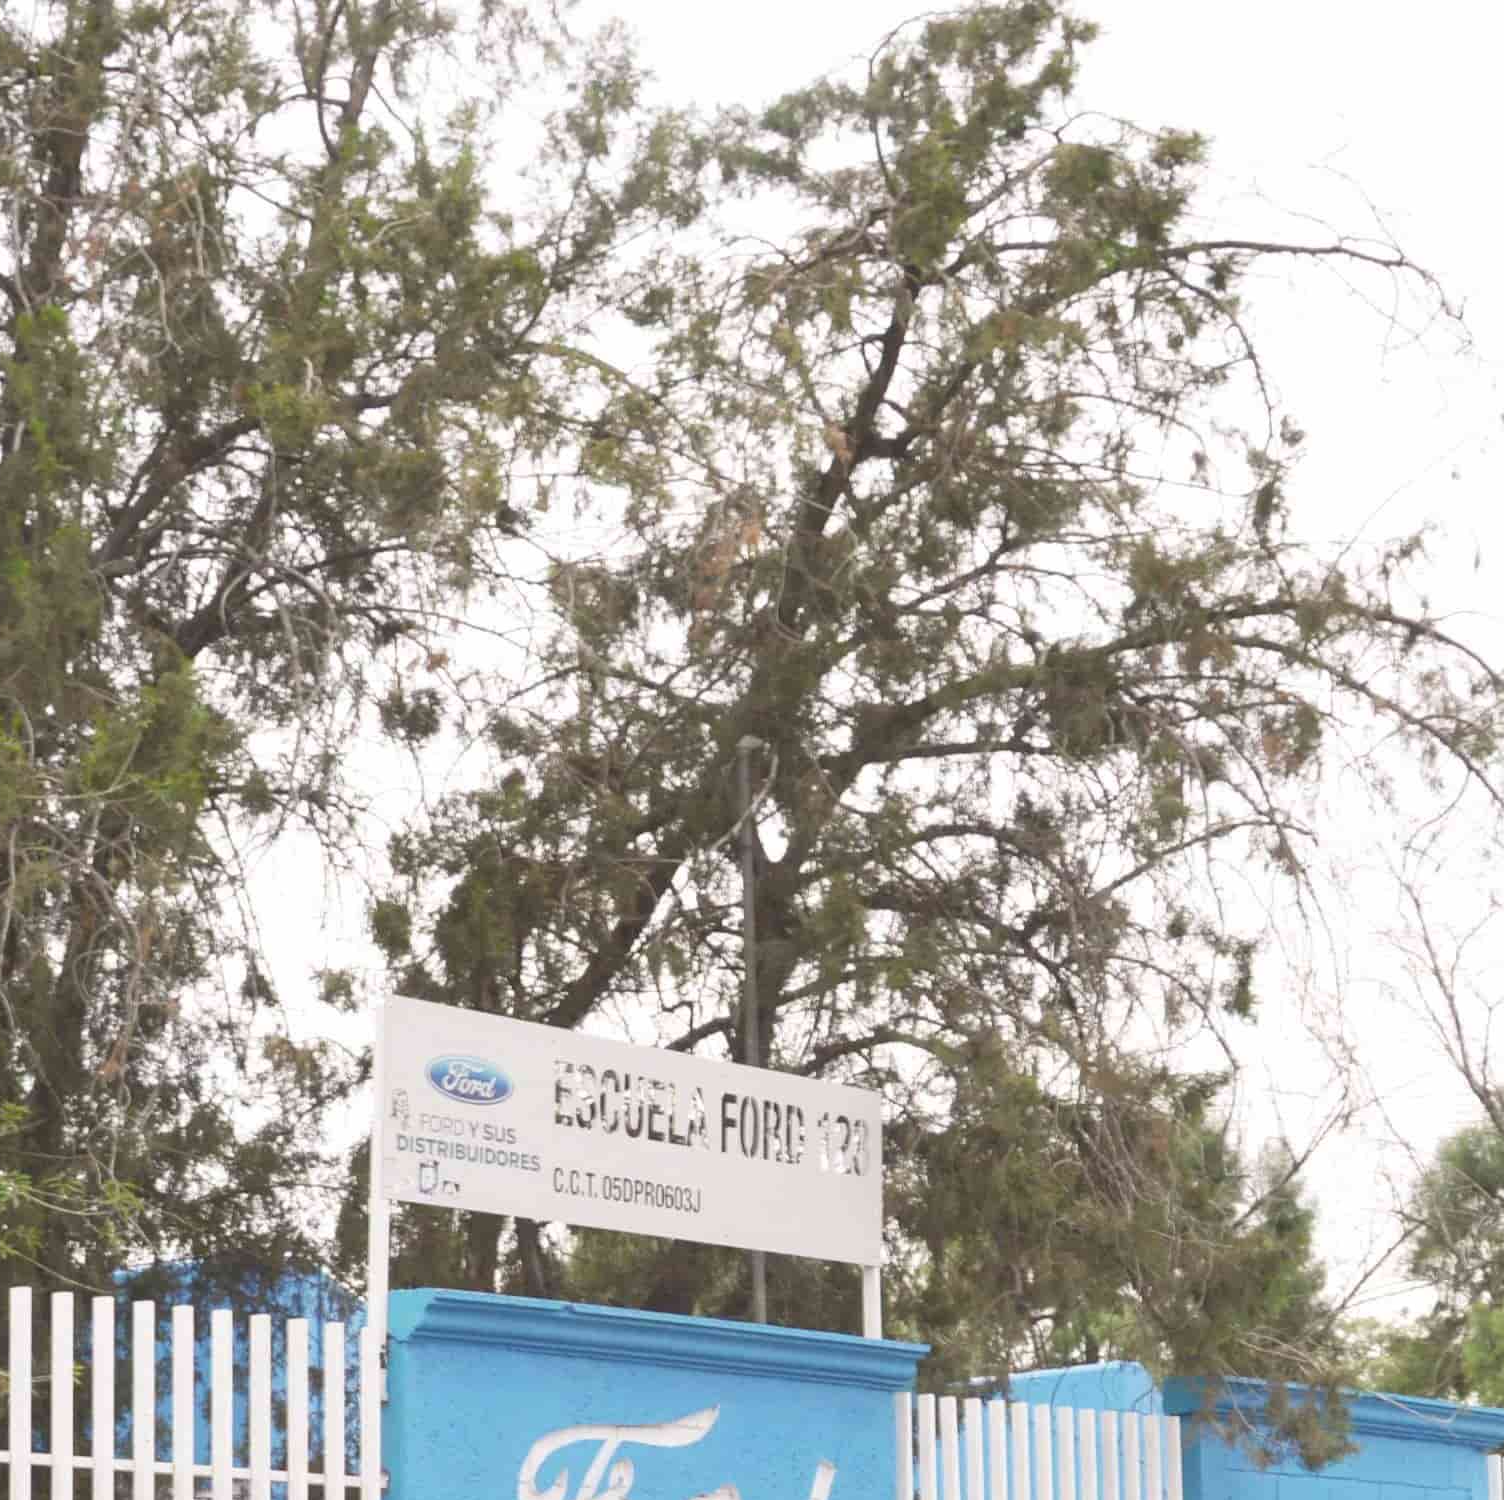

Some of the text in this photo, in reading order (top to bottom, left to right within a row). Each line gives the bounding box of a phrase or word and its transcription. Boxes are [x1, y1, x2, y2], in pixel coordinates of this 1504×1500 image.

[440, 1062, 497, 1099] Ford
[419, 1113, 517, 1145] FORD Y SUS
[554, 1061, 710, 1150] ESCUELA
[721, 1093, 805, 1164] FORD
[396, 1133, 542, 1172] DISTRIBUIDORES
[553, 1167, 702, 1213] C.C.T. 05DPR0603J
